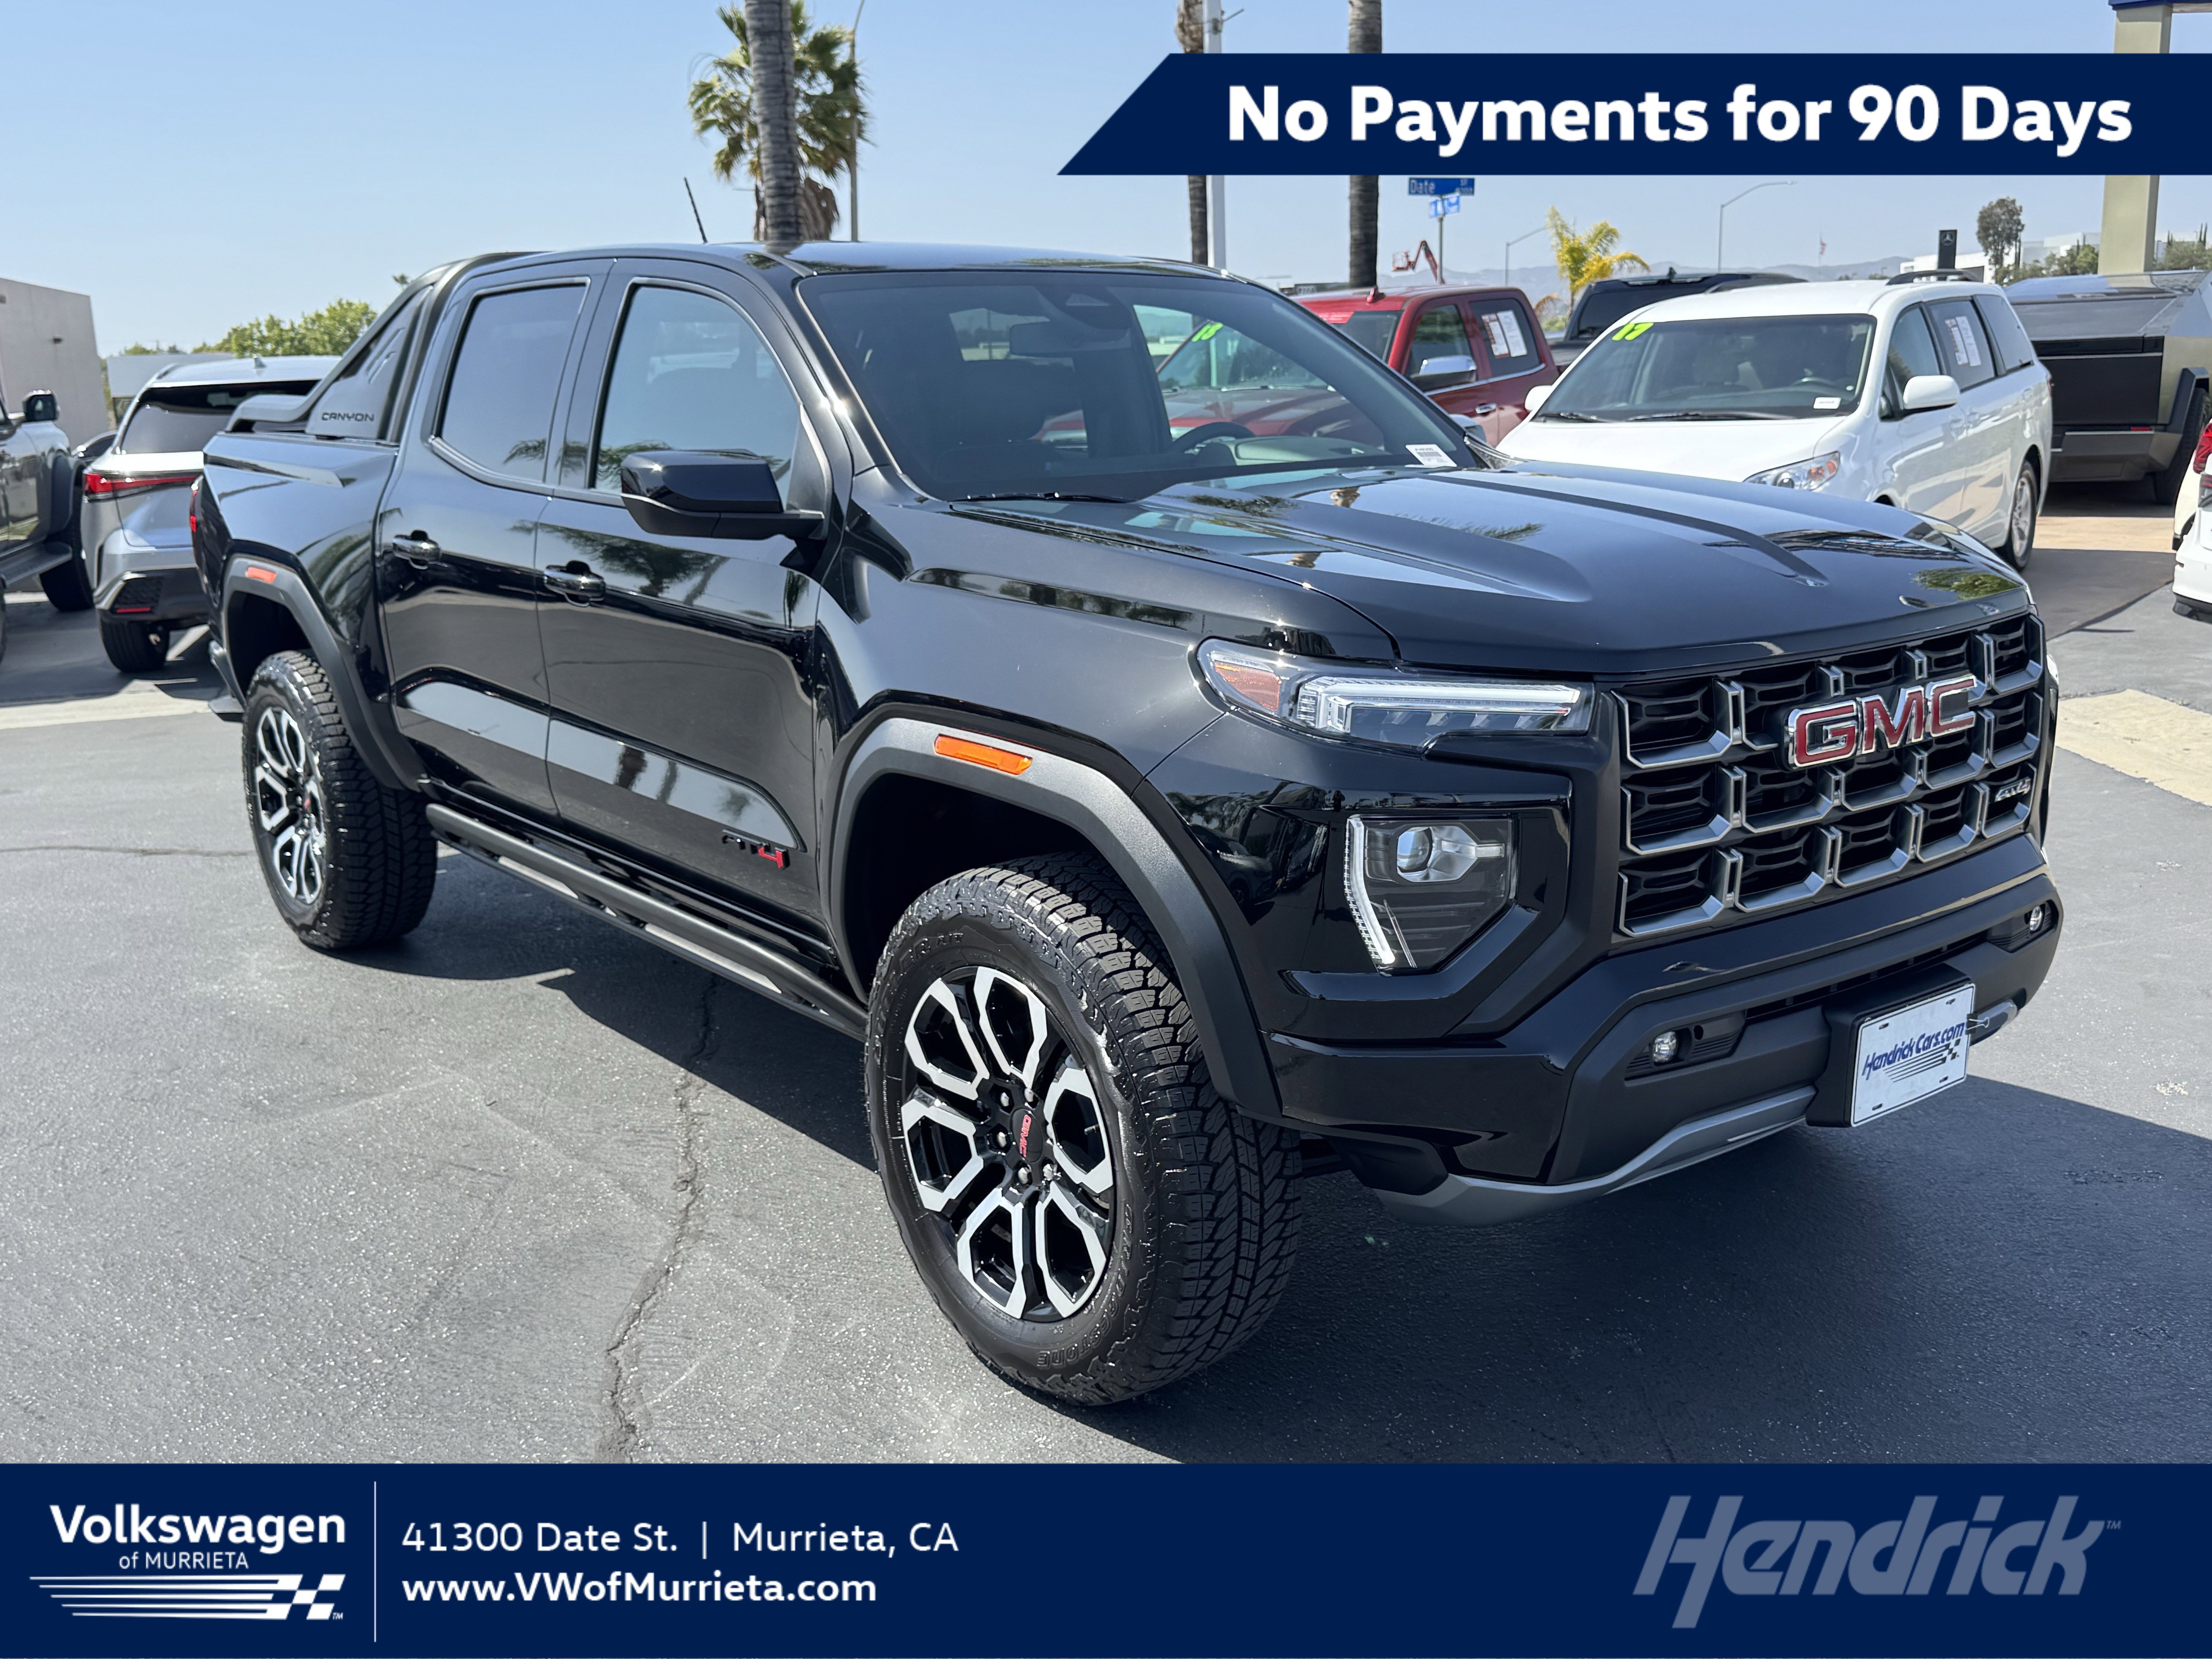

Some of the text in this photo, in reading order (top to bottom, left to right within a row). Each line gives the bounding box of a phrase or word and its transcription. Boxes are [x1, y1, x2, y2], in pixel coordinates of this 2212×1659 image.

[1410, 179, 1436, 193] Date
[1612, 322, 1654, 341] 17
[321, 412, 374, 422] CANYON
[1788, 675, 1977, 767] GMC
